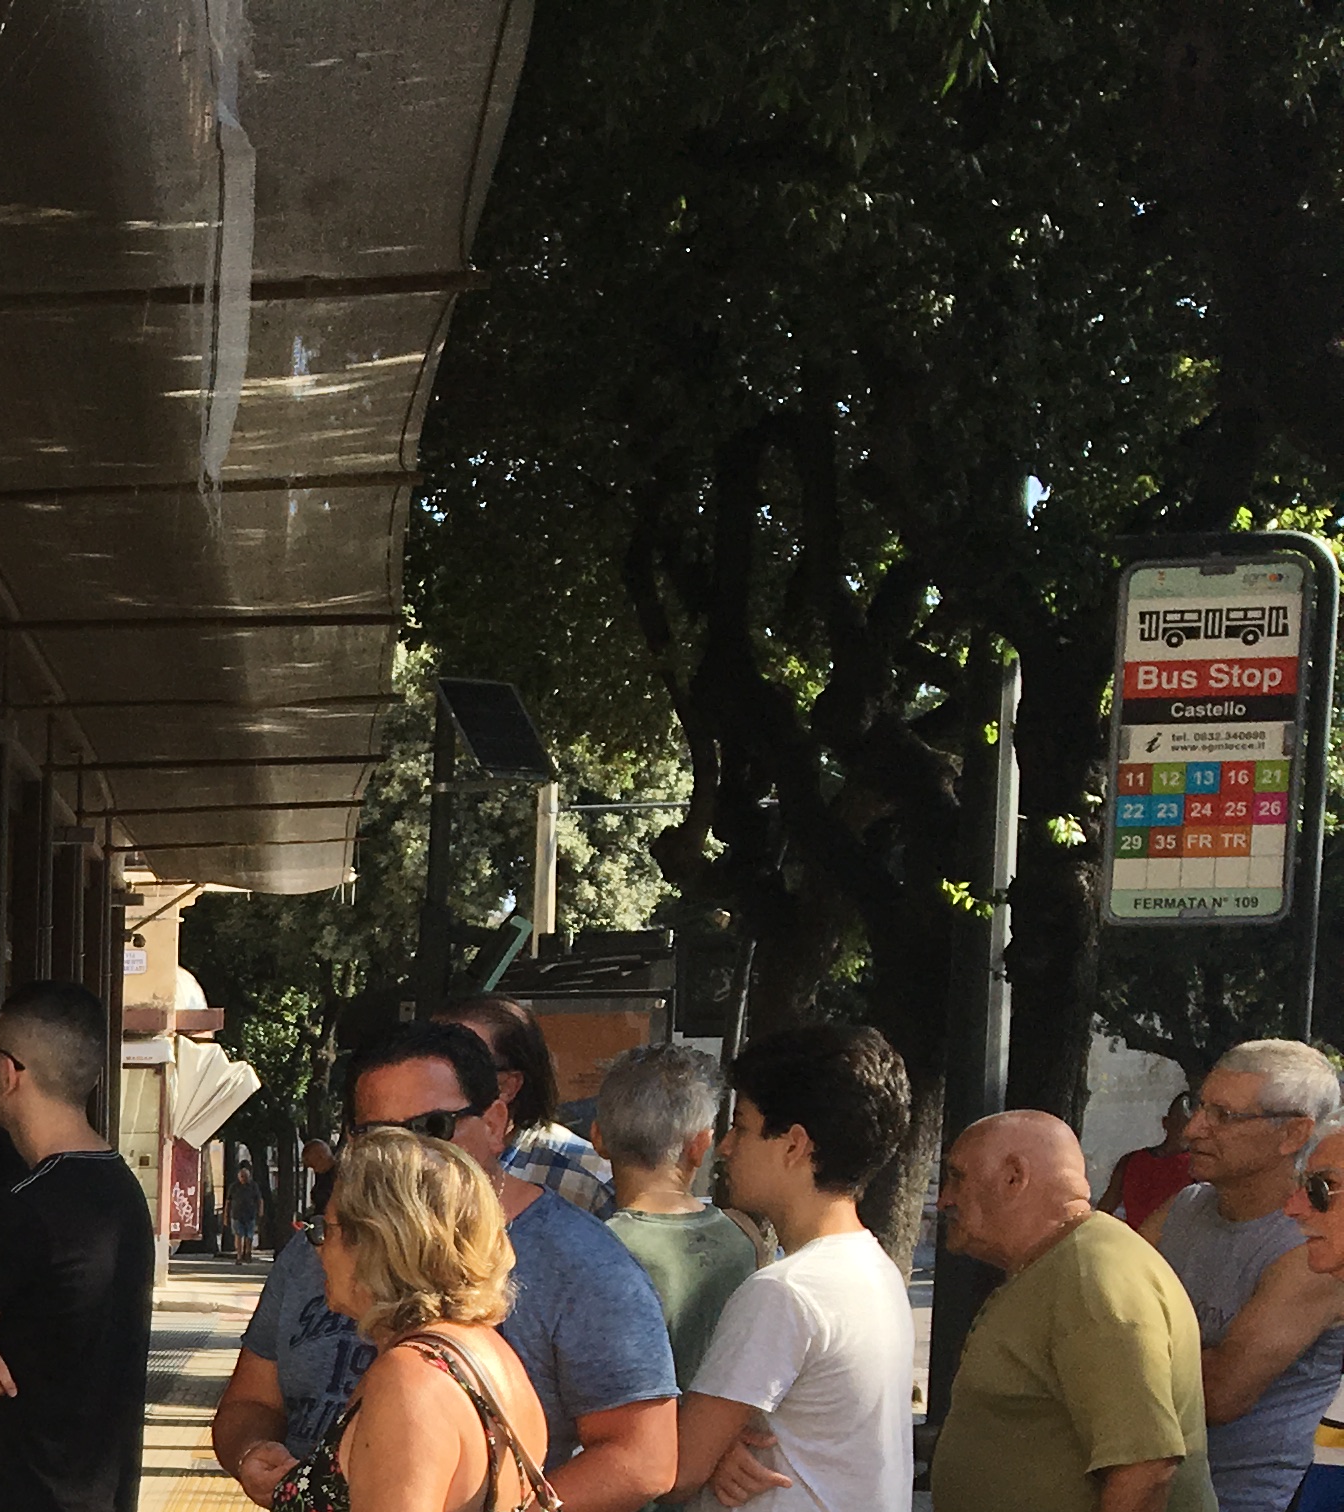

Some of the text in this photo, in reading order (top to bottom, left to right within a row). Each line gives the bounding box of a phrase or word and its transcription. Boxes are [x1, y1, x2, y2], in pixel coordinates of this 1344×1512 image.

[1137, 662, 1283, 693] Bus Stop
[1171, 701, 1247, 718] Castello
[1125, 768, 1282, 787] 11 12 13 16 21
[1122, 801, 1281, 819] 22 23 24 25 26
[1120, 833, 1247, 850] 29 35 FR TR
[1133, 897, 1209, 910] FERMATA
[1235, 896, 1259, 909] 109
